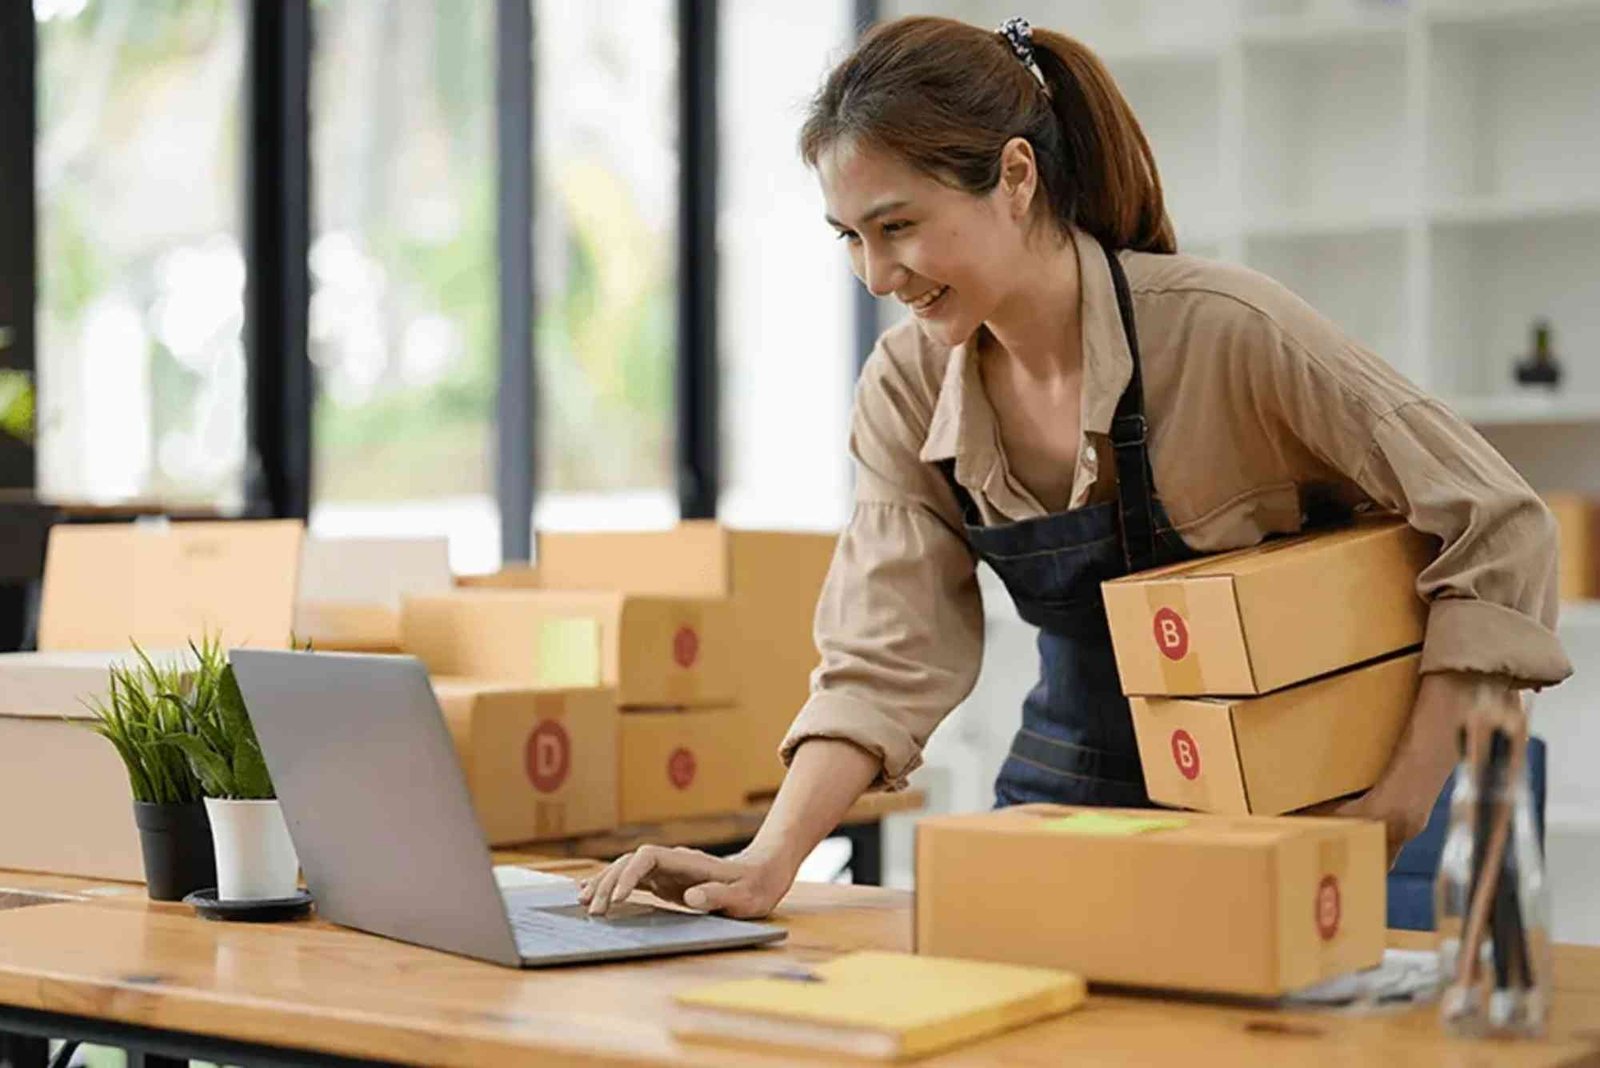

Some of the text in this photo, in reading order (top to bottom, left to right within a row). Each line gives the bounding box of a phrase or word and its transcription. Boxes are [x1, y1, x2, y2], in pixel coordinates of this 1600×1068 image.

[1161, 619, 1180, 648] B
[537, 734, 561, 778] D
[1177, 739, 1194, 768] B
